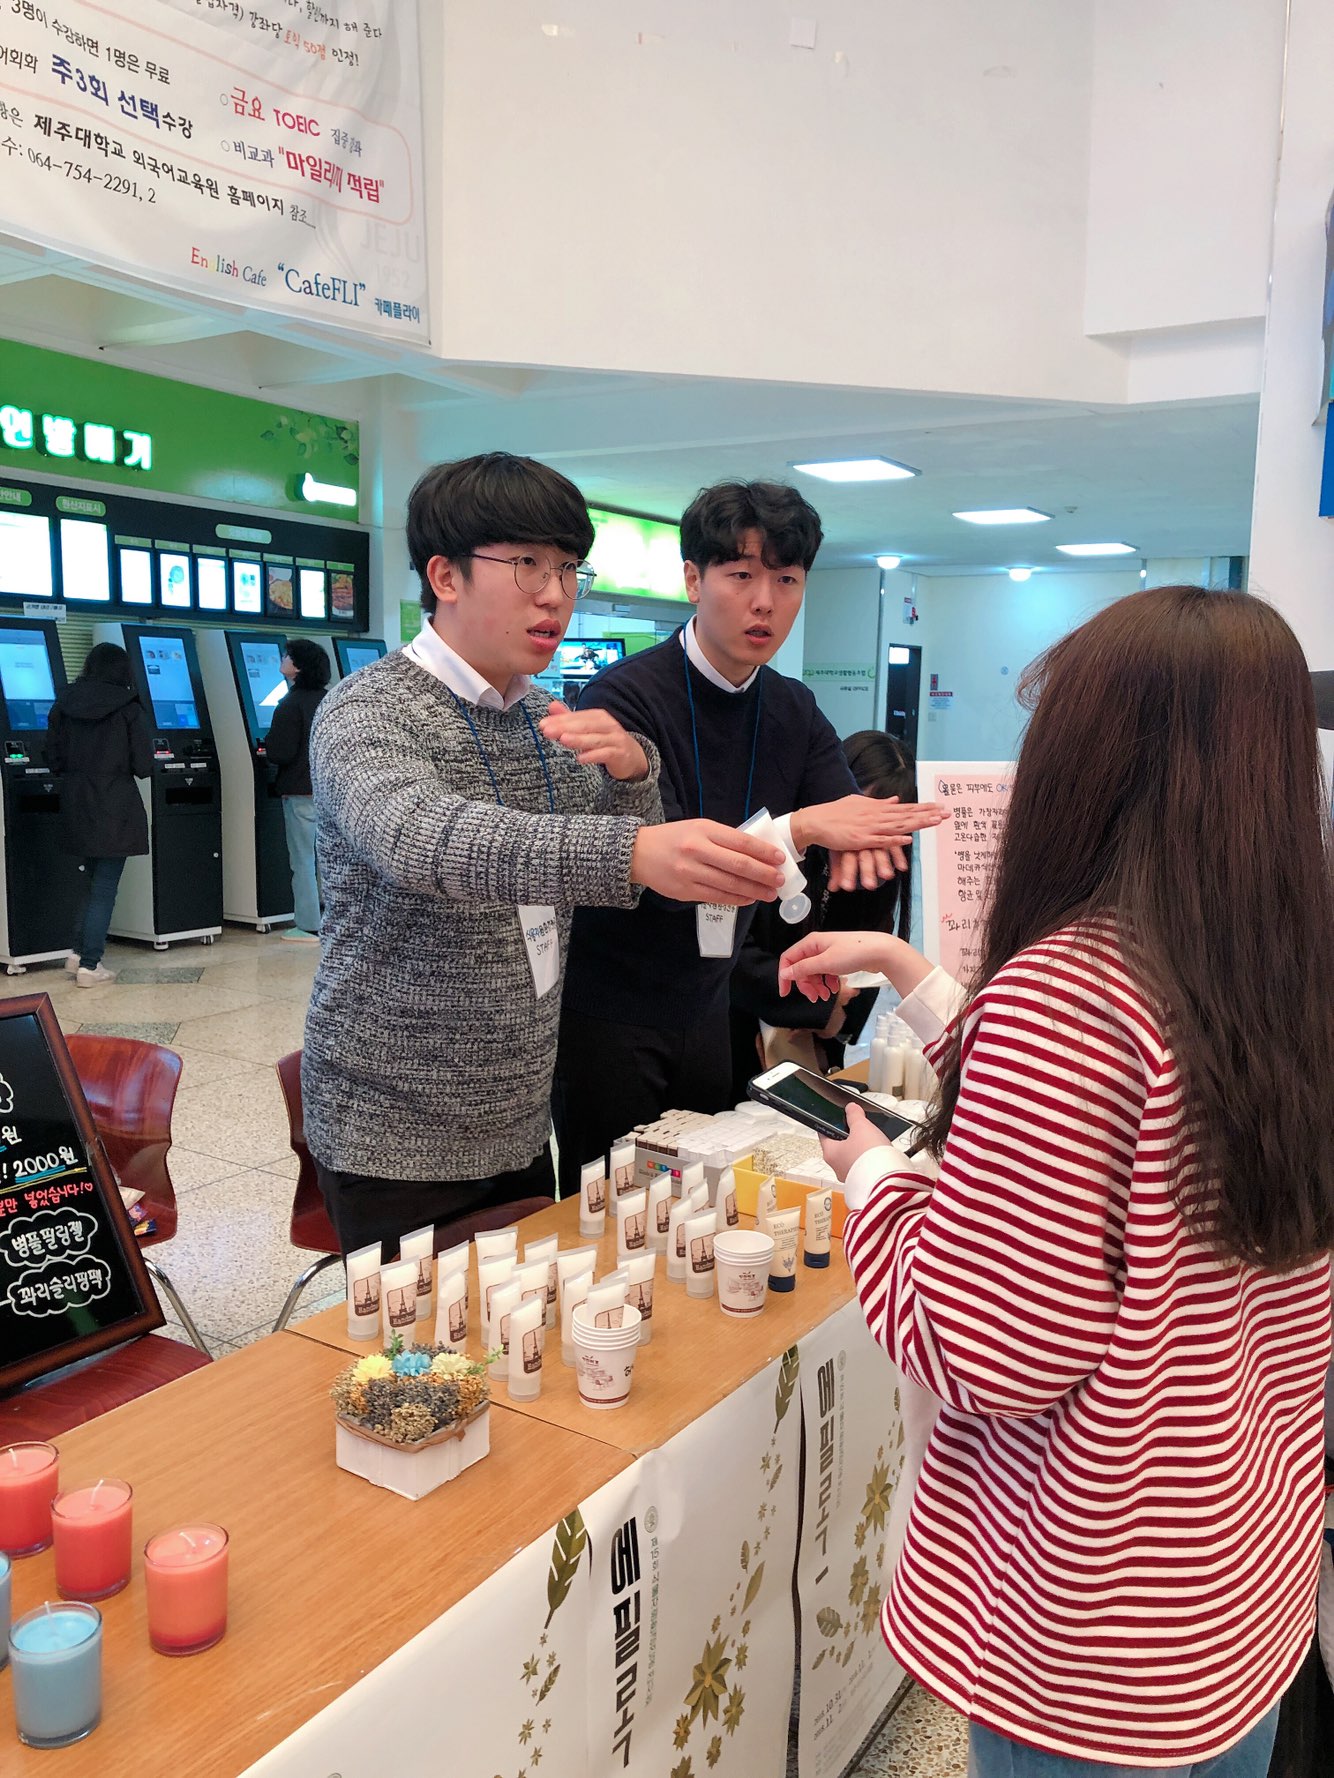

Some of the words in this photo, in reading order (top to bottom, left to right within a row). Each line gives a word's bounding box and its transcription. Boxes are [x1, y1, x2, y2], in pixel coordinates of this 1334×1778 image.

[11, 0, 48, 28] 3명이
[51, 18, 99, 58] 수강하면
[106, 46, 140, 74] 1명은
[144, 61, 171, 85] 무료
[331, 48, 360, 67] 인정!
[52, 54, 109, 106] 주3회
[230, 86, 266, 121] 금요
[273, 108, 321, 137] TOEIC
[33, 114, 126, 159] 제주대학교
[132, 150, 220, 200] 외국어교육원
[227, 184, 285, 217] 홈페이지
[233, 141, 275, 168] 비교과
[27, 147, 143, 202] 064-754-2291,
[148, 187, 157, 204] 2
[242, 265, 267, 287] Cafe
[706, 913, 723, 923] STAFF
[11, 1220, 85, 1258] 병풀필링젤
[773, 1222, 785, 1230] ECO
[17, 1268, 103, 1306] 꽈리슬리핑팩
